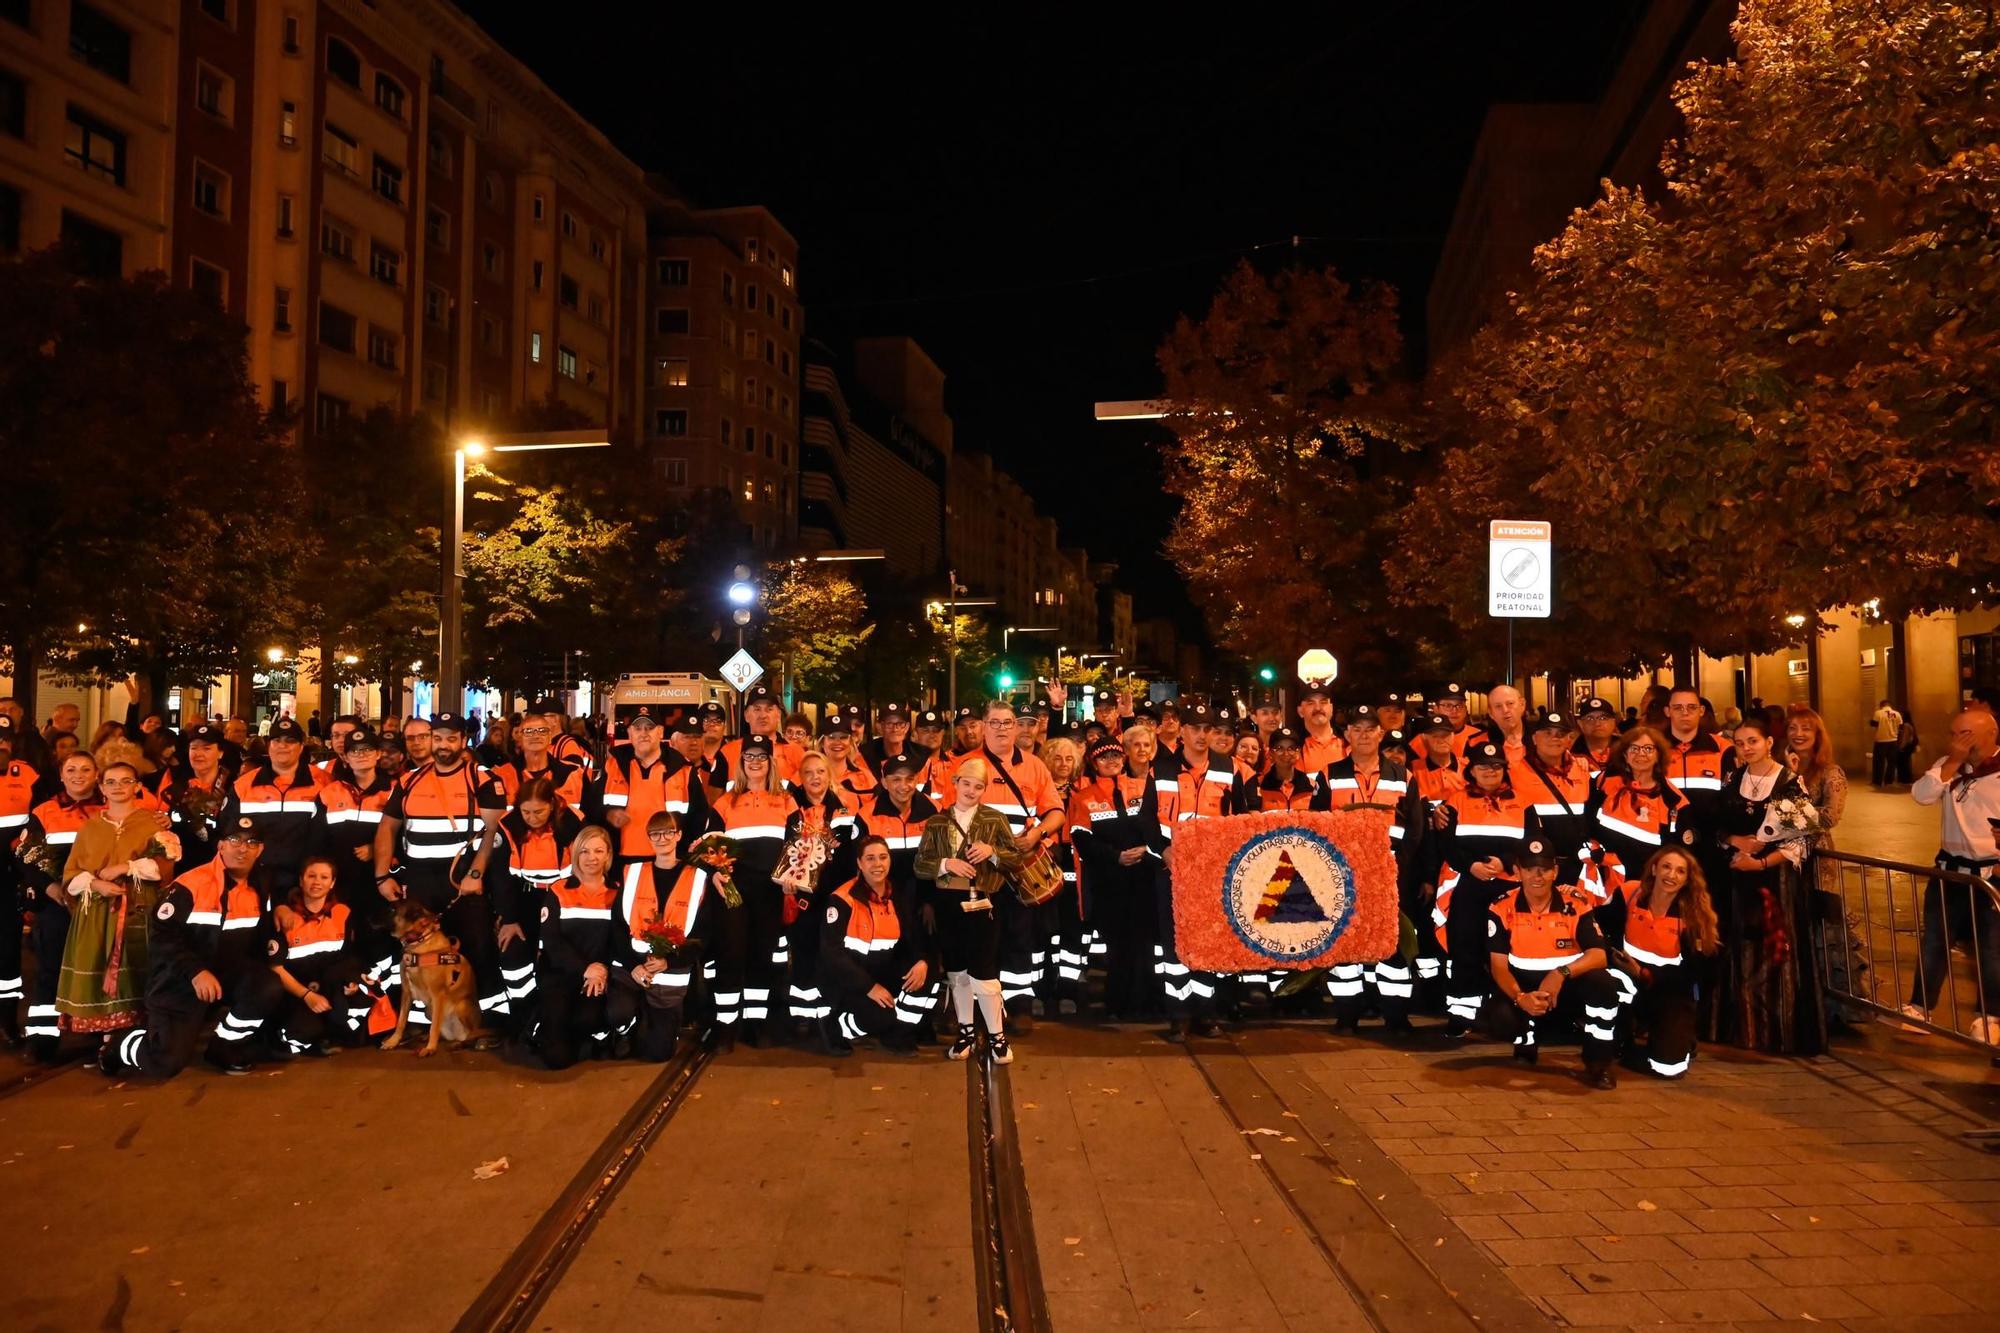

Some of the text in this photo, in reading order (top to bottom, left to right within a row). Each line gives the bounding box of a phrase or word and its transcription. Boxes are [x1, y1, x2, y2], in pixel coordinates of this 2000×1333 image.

[1496, 592, 1545, 600] PRIORIDAD
[1497, 603, 1543, 612] PEATONAL
[732, 663, 751, 678] 30
[624, 688, 691, 698] AMBULANCIA
[1296, 837, 1309, 848] DE
[1244, 836, 1294, 864] VOLUNTARIOS
[1236, 864, 1248, 877] DE
[1232, 878, 1256, 936] AGRUPACIONES
[1333, 892, 1344, 912] CIVIL
[1255, 934, 1267, 945] DE
[1266, 938, 1286, 953] RED
